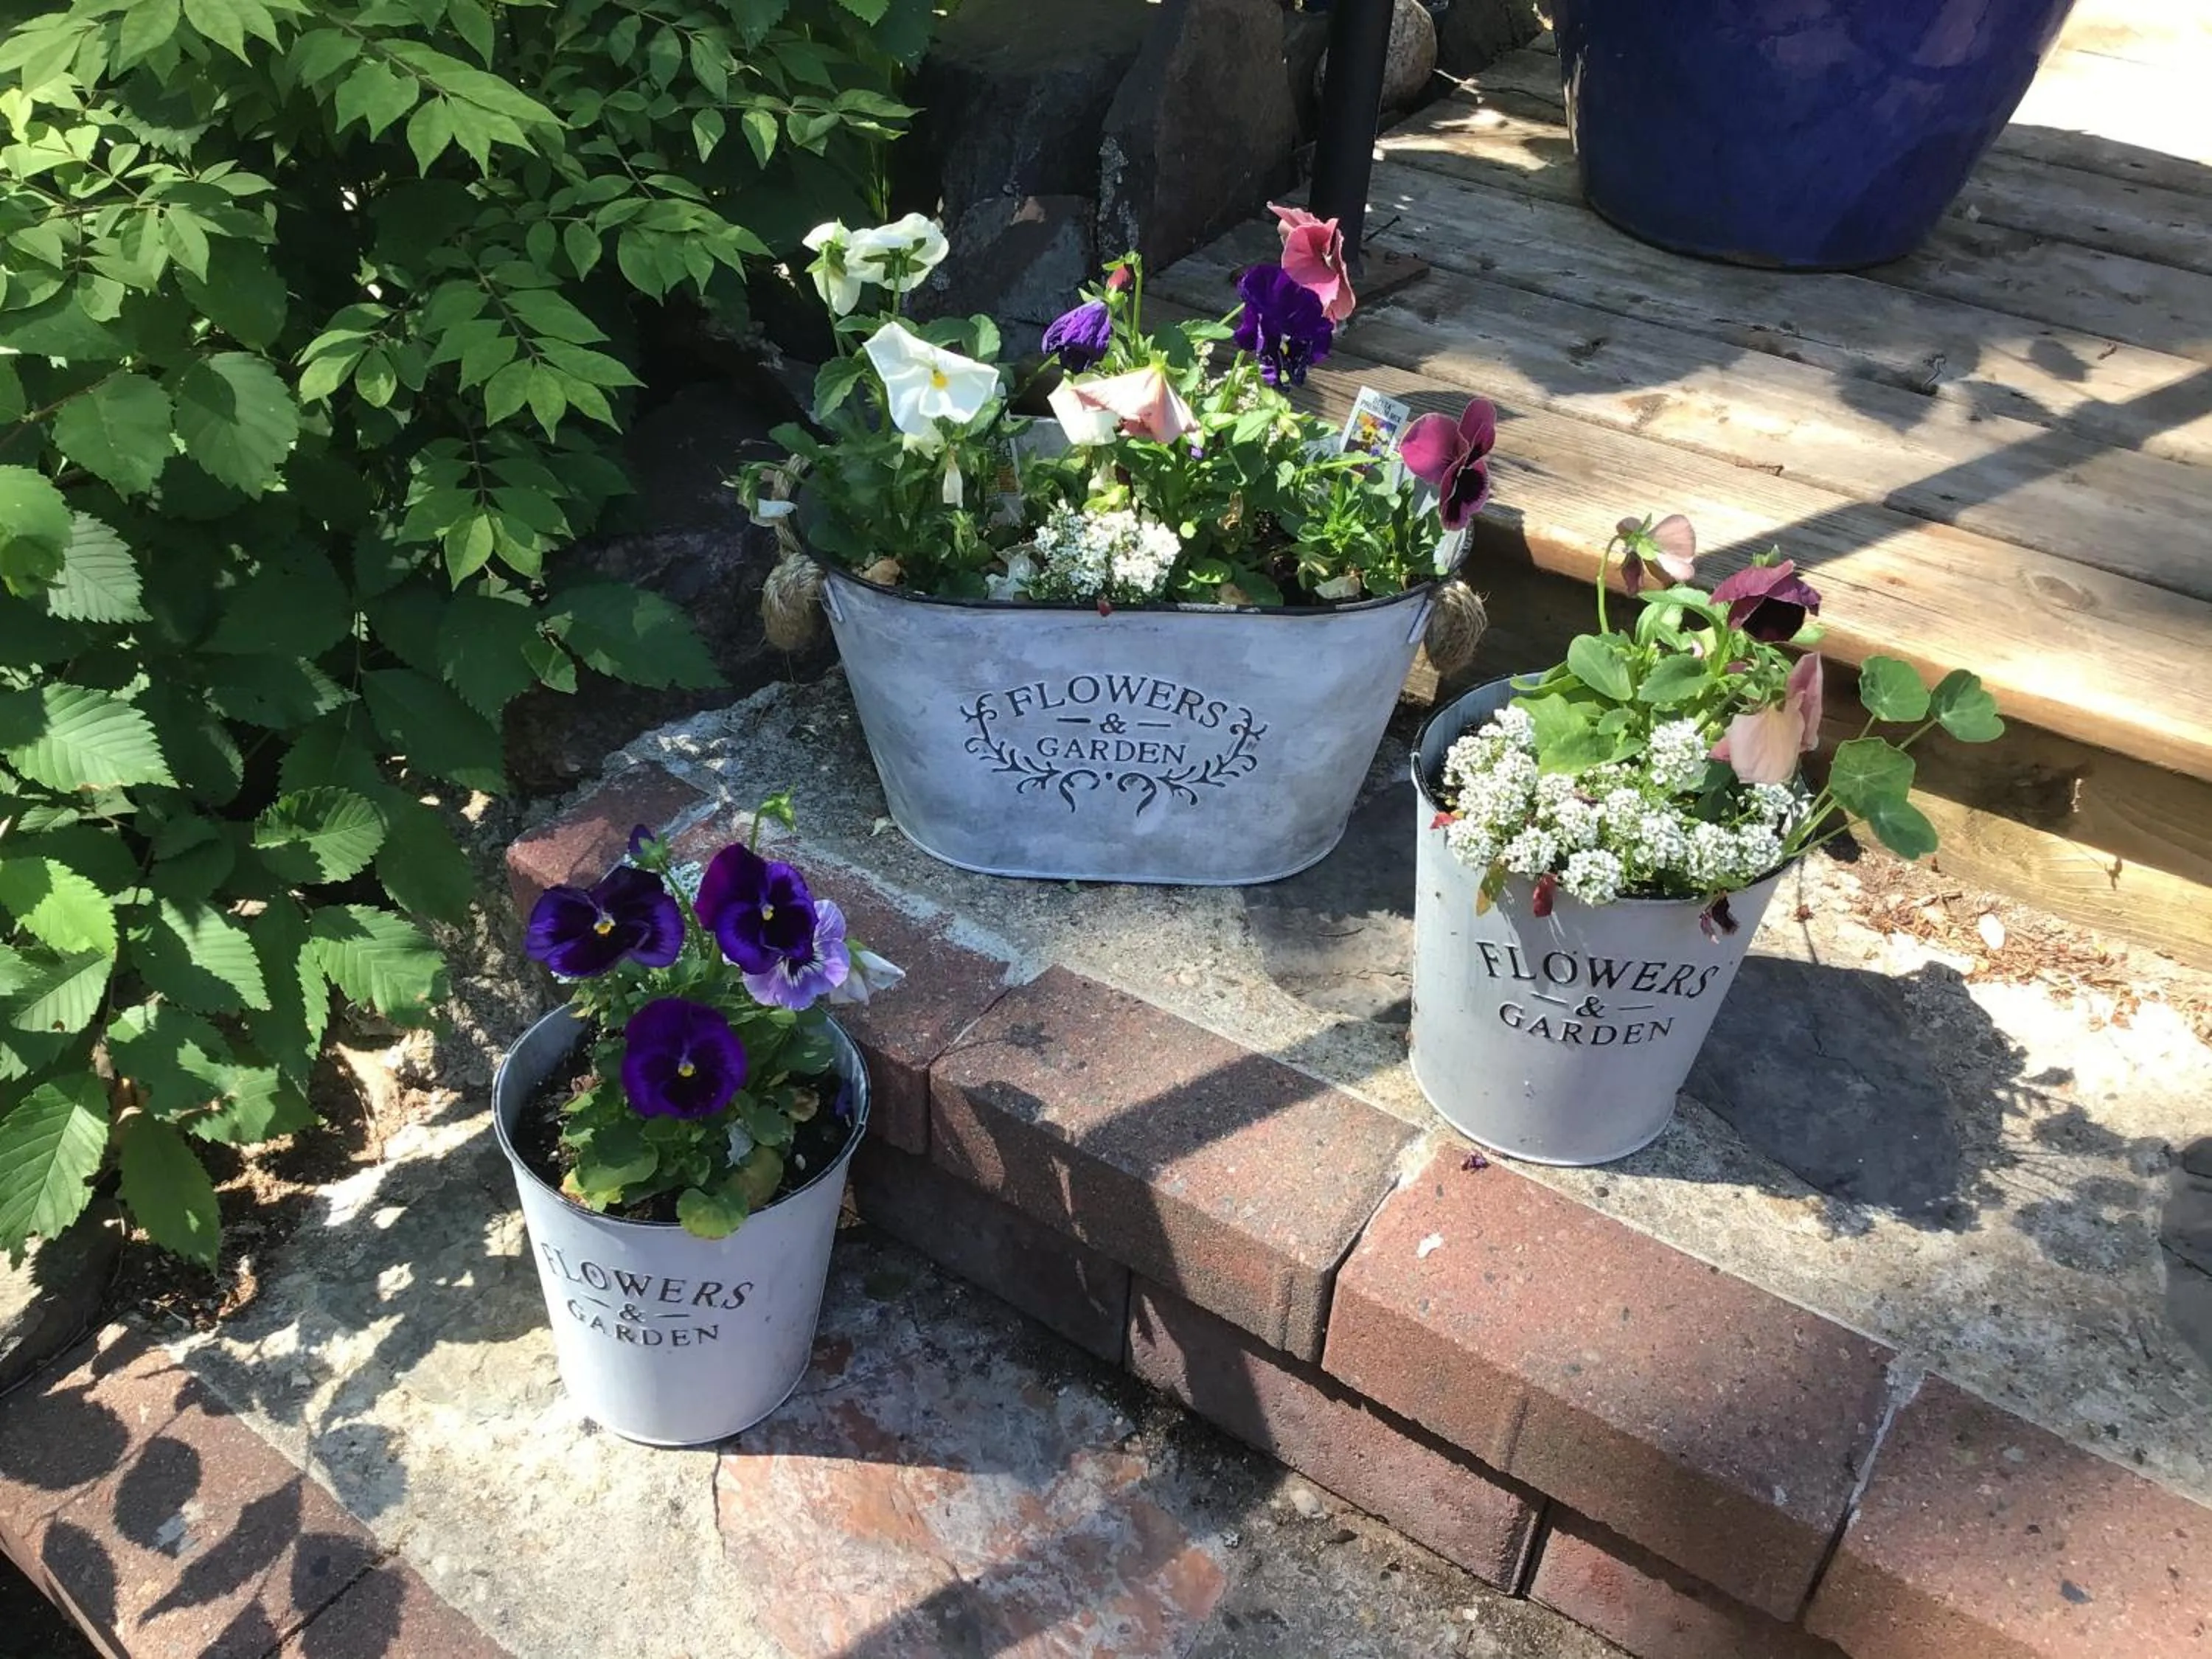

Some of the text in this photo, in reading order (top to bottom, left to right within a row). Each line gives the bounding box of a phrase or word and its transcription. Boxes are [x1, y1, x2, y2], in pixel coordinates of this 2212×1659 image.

[1005, 674, 1228, 728] FLOWERS
[1099, 712, 1127, 734] &
[1036, 737, 1186, 765] GARDEN
[1475, 941, 1719, 999] FLOWERS
[1498, 1001, 1674, 1046] GARDEN
[1575, 995, 1605, 1018] &
[540, 1242, 754, 1310] FLOWERS
[567, 1298, 720, 1347] GARDEN
[618, 1303, 646, 1324] &
